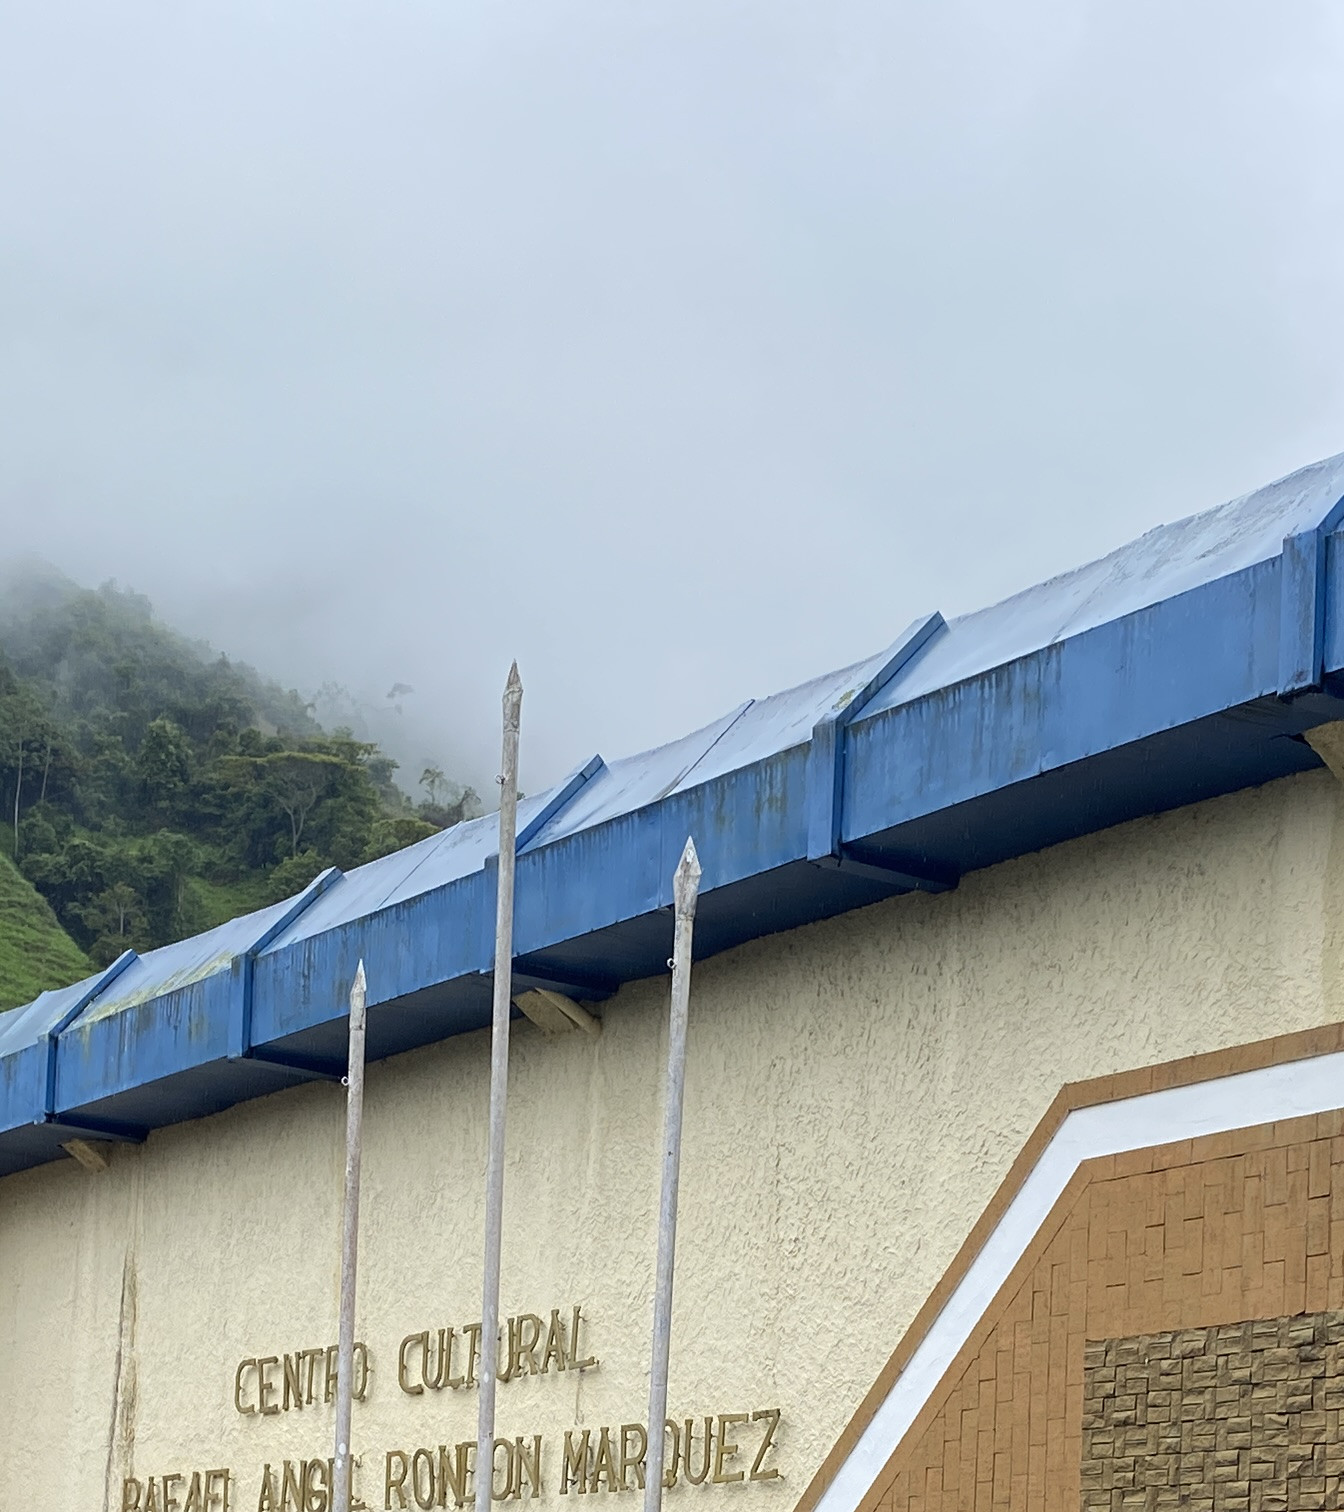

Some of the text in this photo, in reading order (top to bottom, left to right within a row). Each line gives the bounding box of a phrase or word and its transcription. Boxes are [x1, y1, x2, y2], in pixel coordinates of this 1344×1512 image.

[235, 1306, 595, 1415] CENTRO CULTURAL
[385, 1435, 542, 1510] RONDON
[559, 1408, 780, 1495] MARQUEZ
